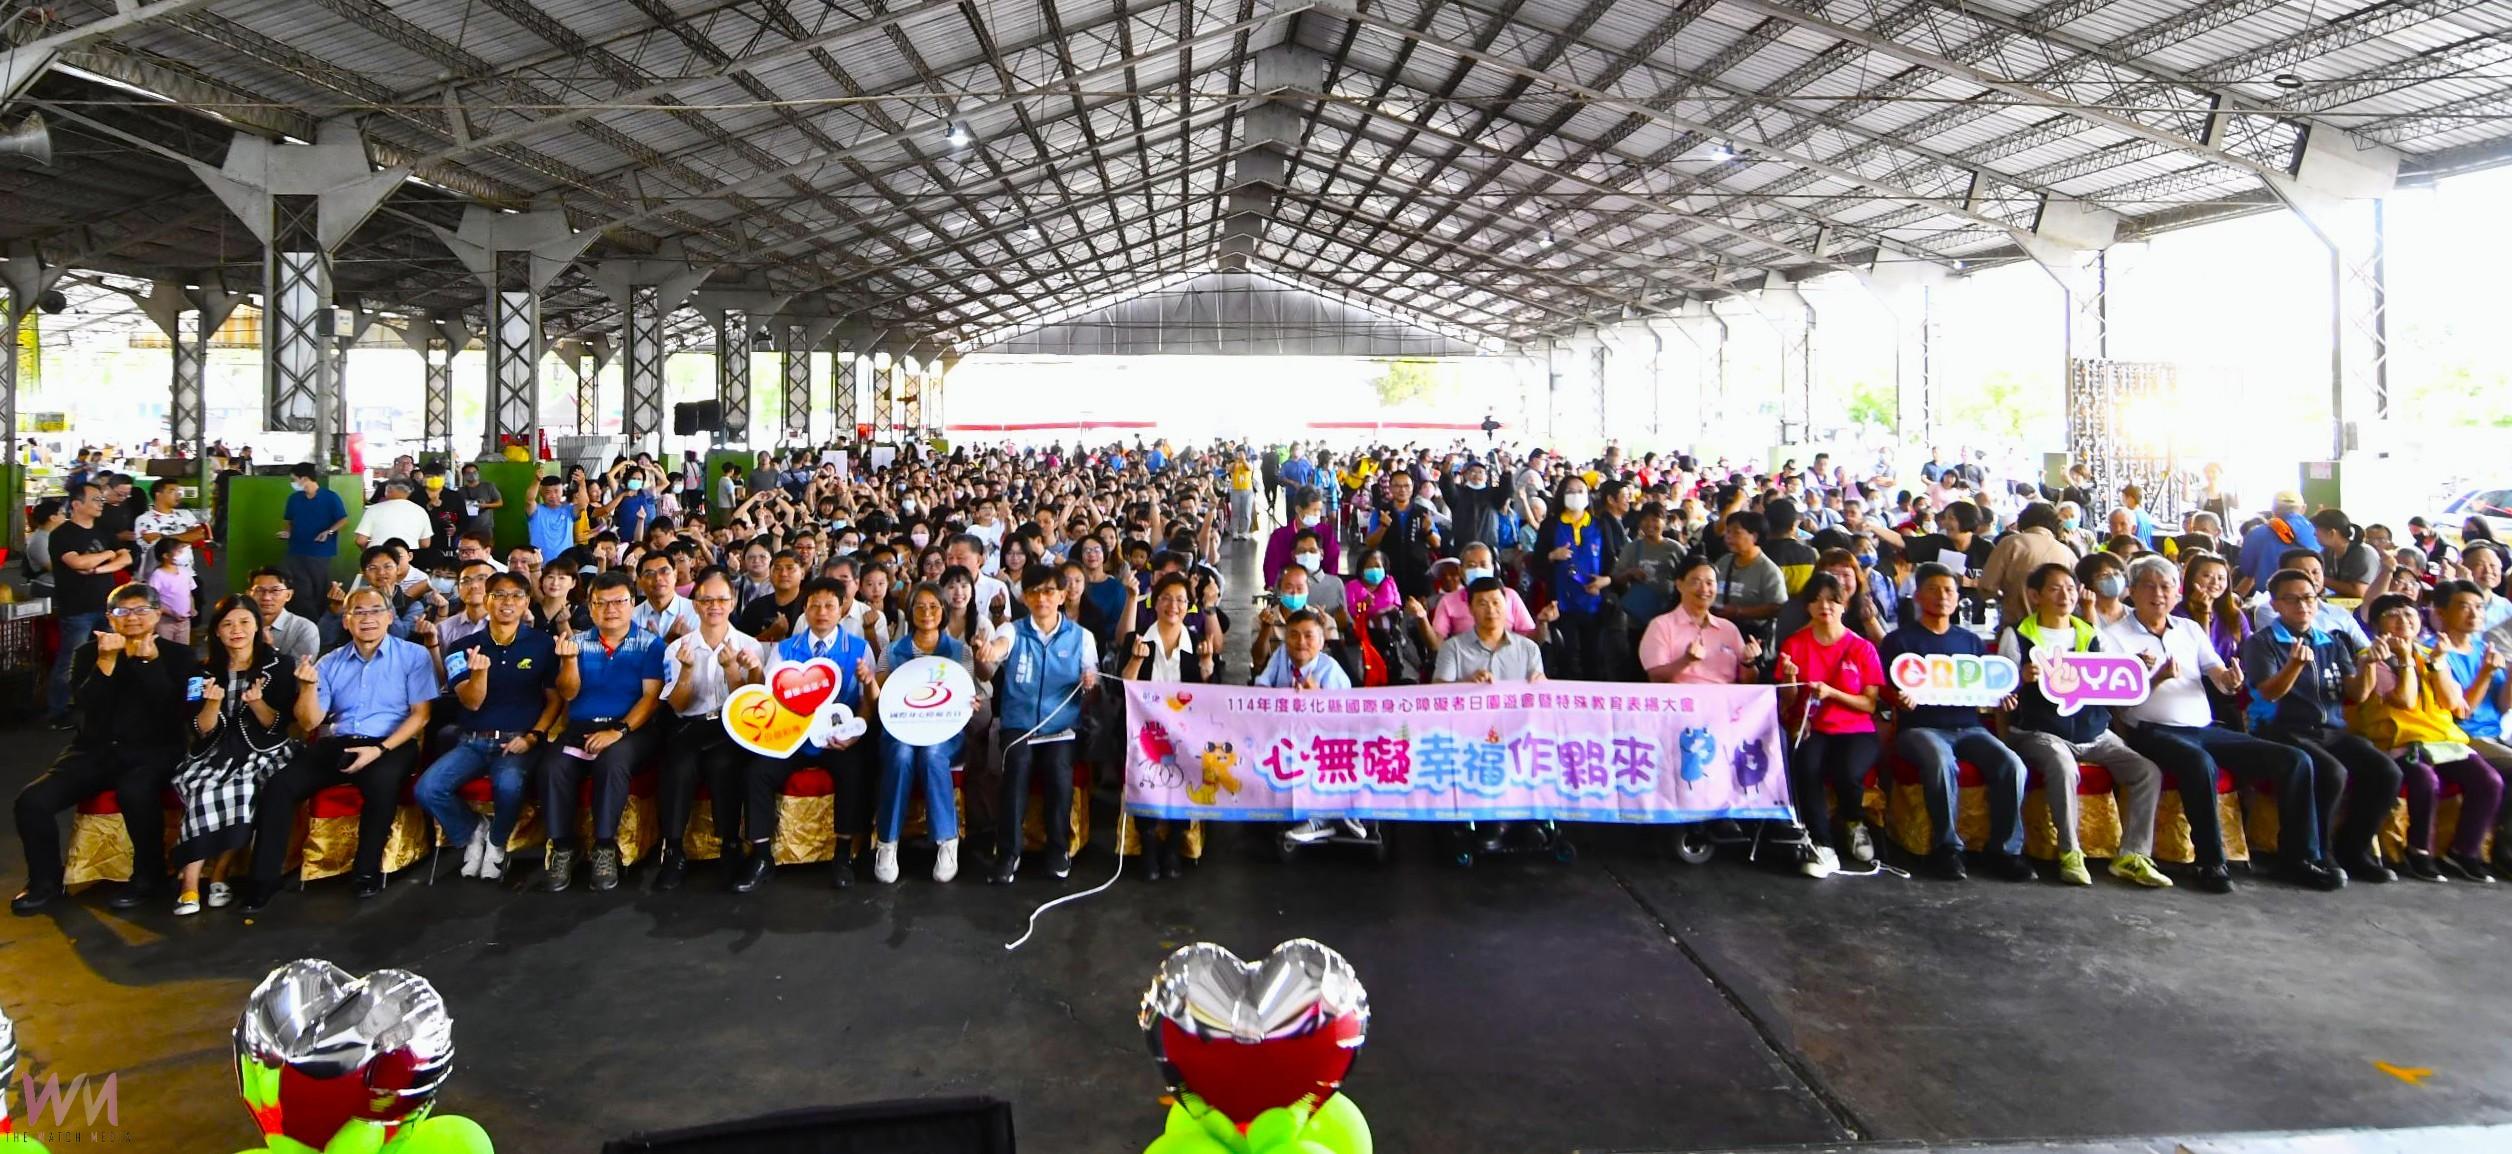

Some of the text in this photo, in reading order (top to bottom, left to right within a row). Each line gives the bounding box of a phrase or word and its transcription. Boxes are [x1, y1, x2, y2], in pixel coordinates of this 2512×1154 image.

[1897, 658, 2013, 690] CRPD
[2081, 667, 2138, 692] YA
[1262, 732, 1657, 790] 心無礙幸福作點來
